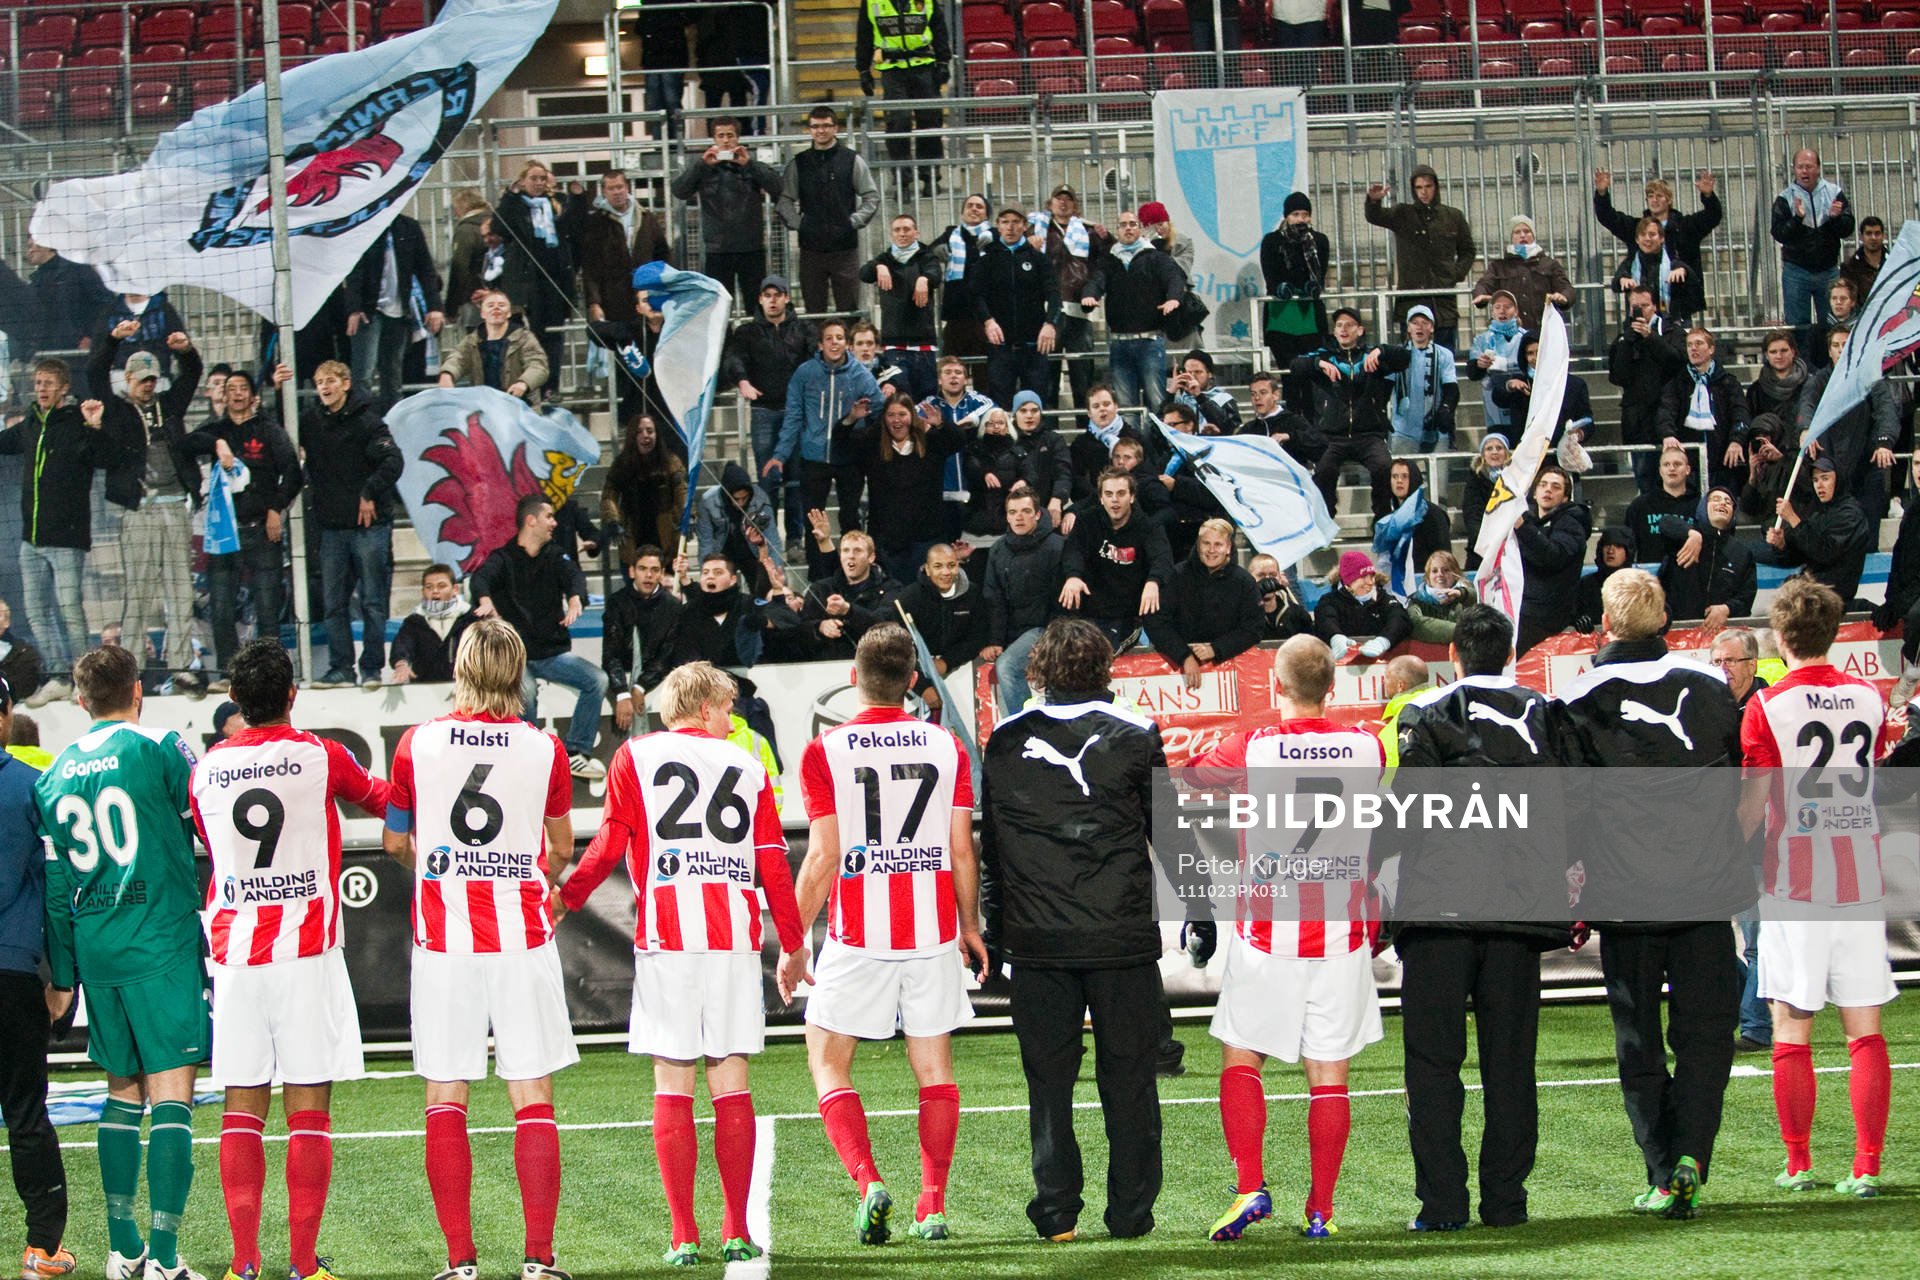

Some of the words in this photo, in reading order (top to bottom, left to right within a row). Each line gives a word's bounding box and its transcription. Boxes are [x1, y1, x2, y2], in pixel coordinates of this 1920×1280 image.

[1192, 272, 1259, 302] almö
[1844, 651, 1879, 676] AB
[1806, 692, 1856, 710] Malm
[450, 727, 509, 747] Halsti
[847, 730, 928, 750] Pekalski
[1279, 742, 1353, 760] Larsson
[1796, 720, 1872, 799] 23
[62, 755, 119, 779] Garaca
[208, 757, 302, 789] Figueiredo
[450, 763, 504, 847] 6
[653, 761, 751, 845] 26
[854, 762, 939, 847] 17
[56, 785, 139, 873] 30
[232, 787, 285, 869] 9
[455, 851, 532, 866] HILDING
[871, 847, 942, 861] HILDING
[456, 865, 532, 879] ANDERS
[870, 859, 942, 874] ANDERS
[240, 869, 316, 890] HILDING
[243, 883, 318, 903] ANDERS
